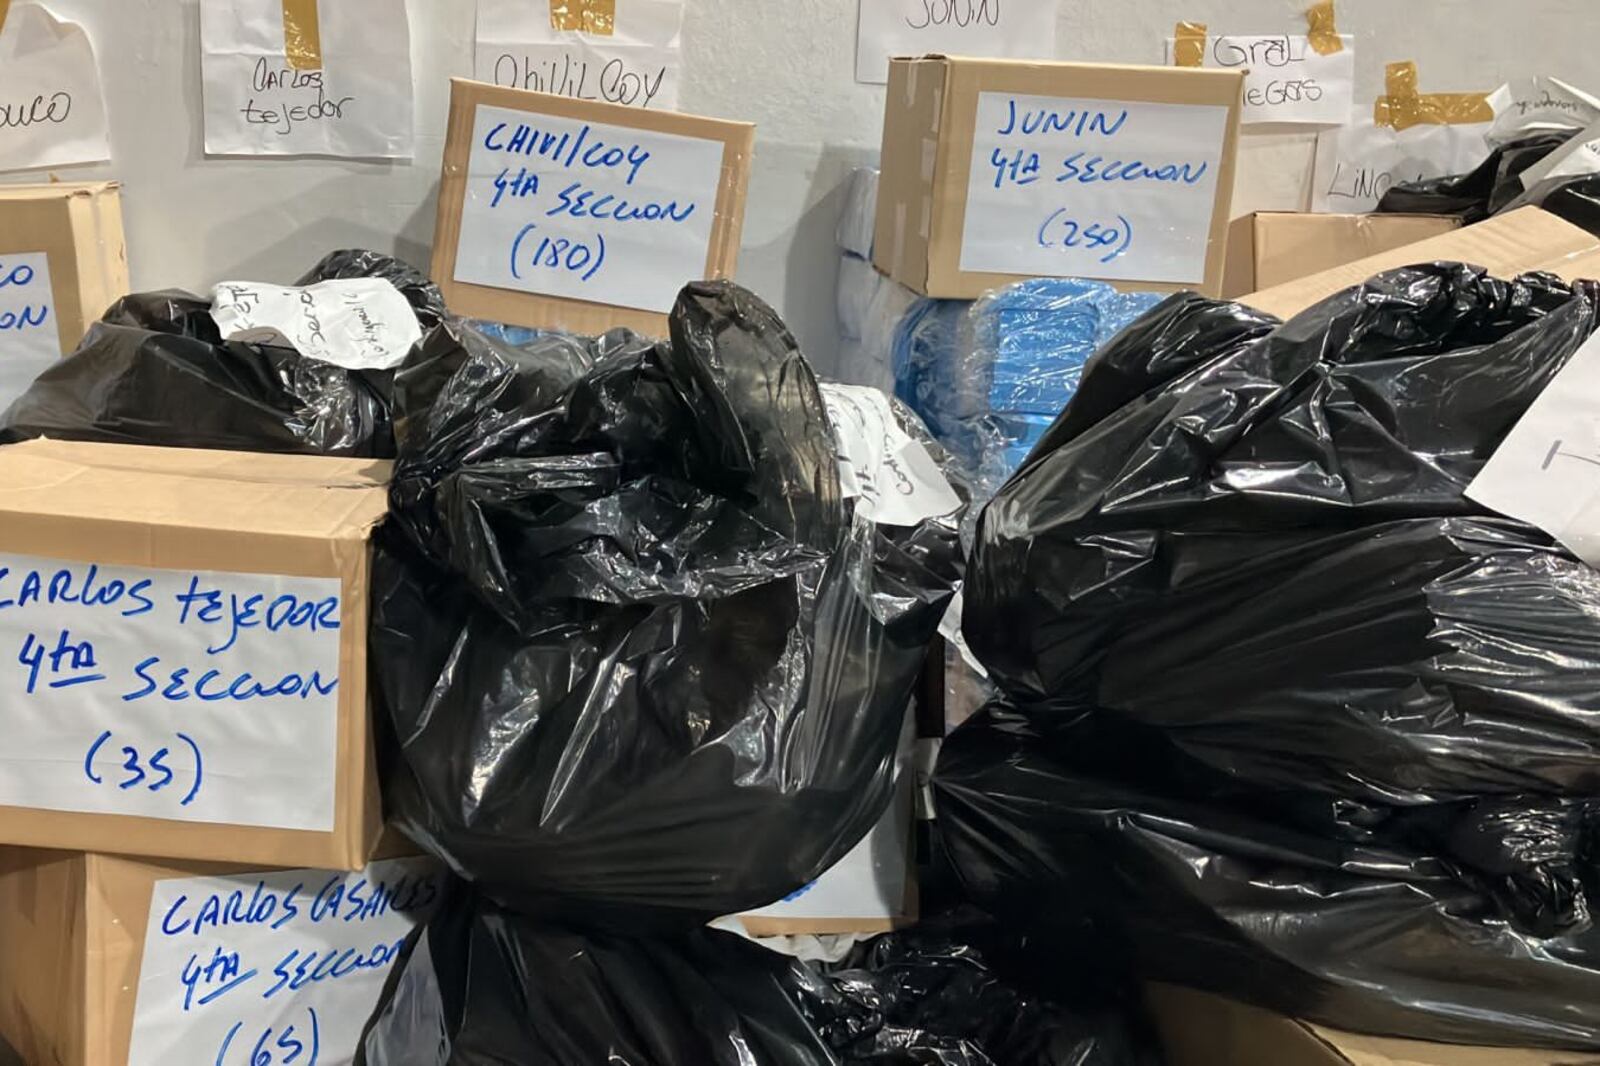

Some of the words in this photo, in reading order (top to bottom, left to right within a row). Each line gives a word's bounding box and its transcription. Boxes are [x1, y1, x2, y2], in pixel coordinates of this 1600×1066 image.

[997, 100, 1128, 137] JUNIN
[1056, 152, 1207, 184] SECCION
[546, 183, 696, 222] SECCION
[510, 223, 606, 282] (180)
[1037, 207, 1132, 263] (250)
[122, 655, 339, 701] SECCION
[84, 730, 204, 807] (35)
[214, 1006, 320, 1066] (65)
